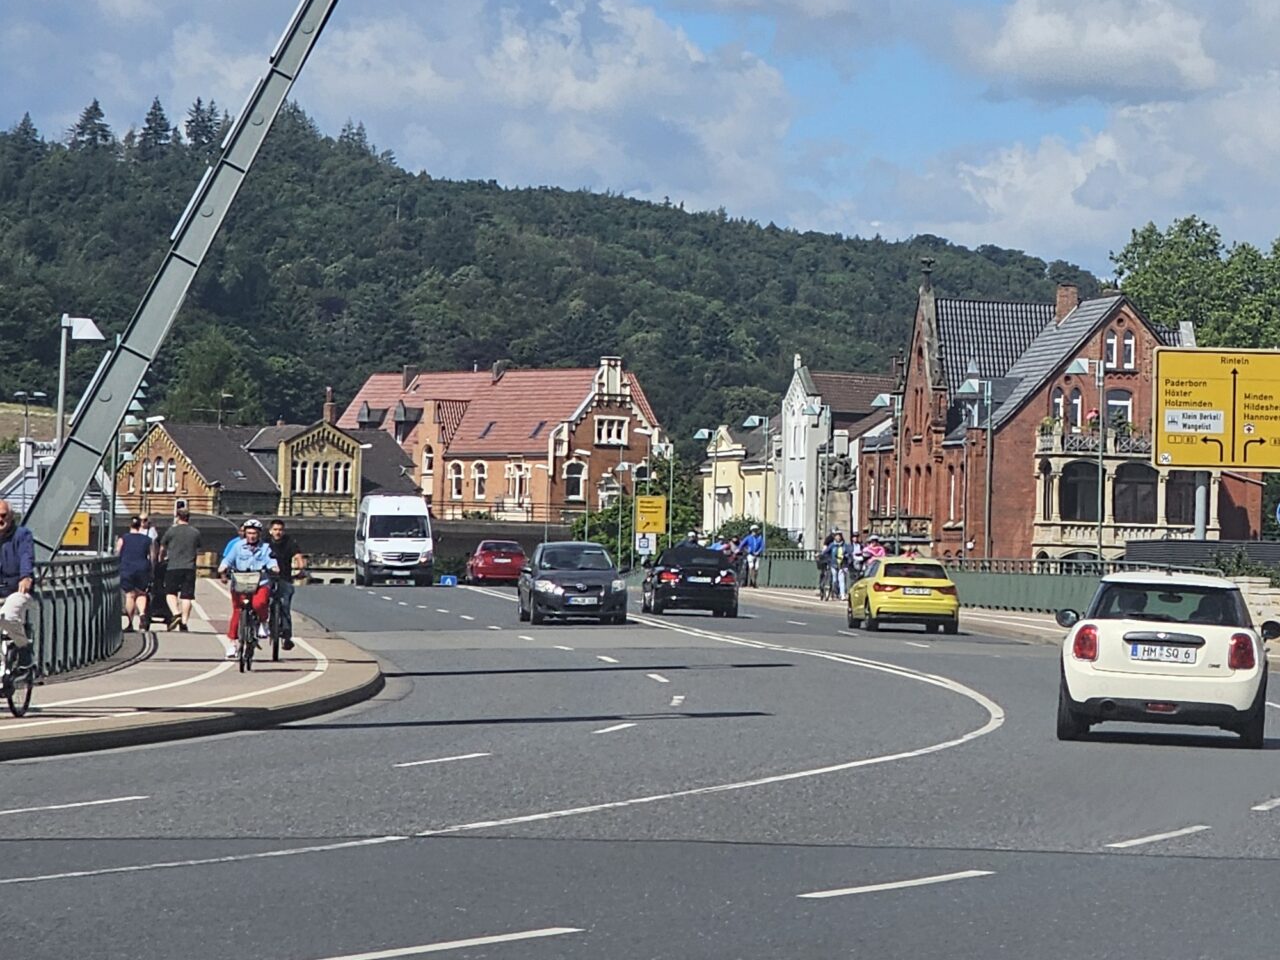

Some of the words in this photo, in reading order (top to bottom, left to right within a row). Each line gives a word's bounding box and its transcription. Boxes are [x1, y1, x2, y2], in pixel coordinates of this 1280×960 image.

[1220, 356, 1249, 365] Rinteln
[1164, 379, 1207, 388] Paderborn
[1164, 389, 1192, 397] Höxter
[1244, 393, 1273, 401] Minden
[1164, 399, 1213, 408] Holzminden
[1182, 412, 1197, 420] Klein
[1182, 422, 1211, 432] Wangelist
[1142, 647, 1157, 657] HM
[1165, 647, 1179, 659] SQ
[1184, 649, 1191, 659] 6
